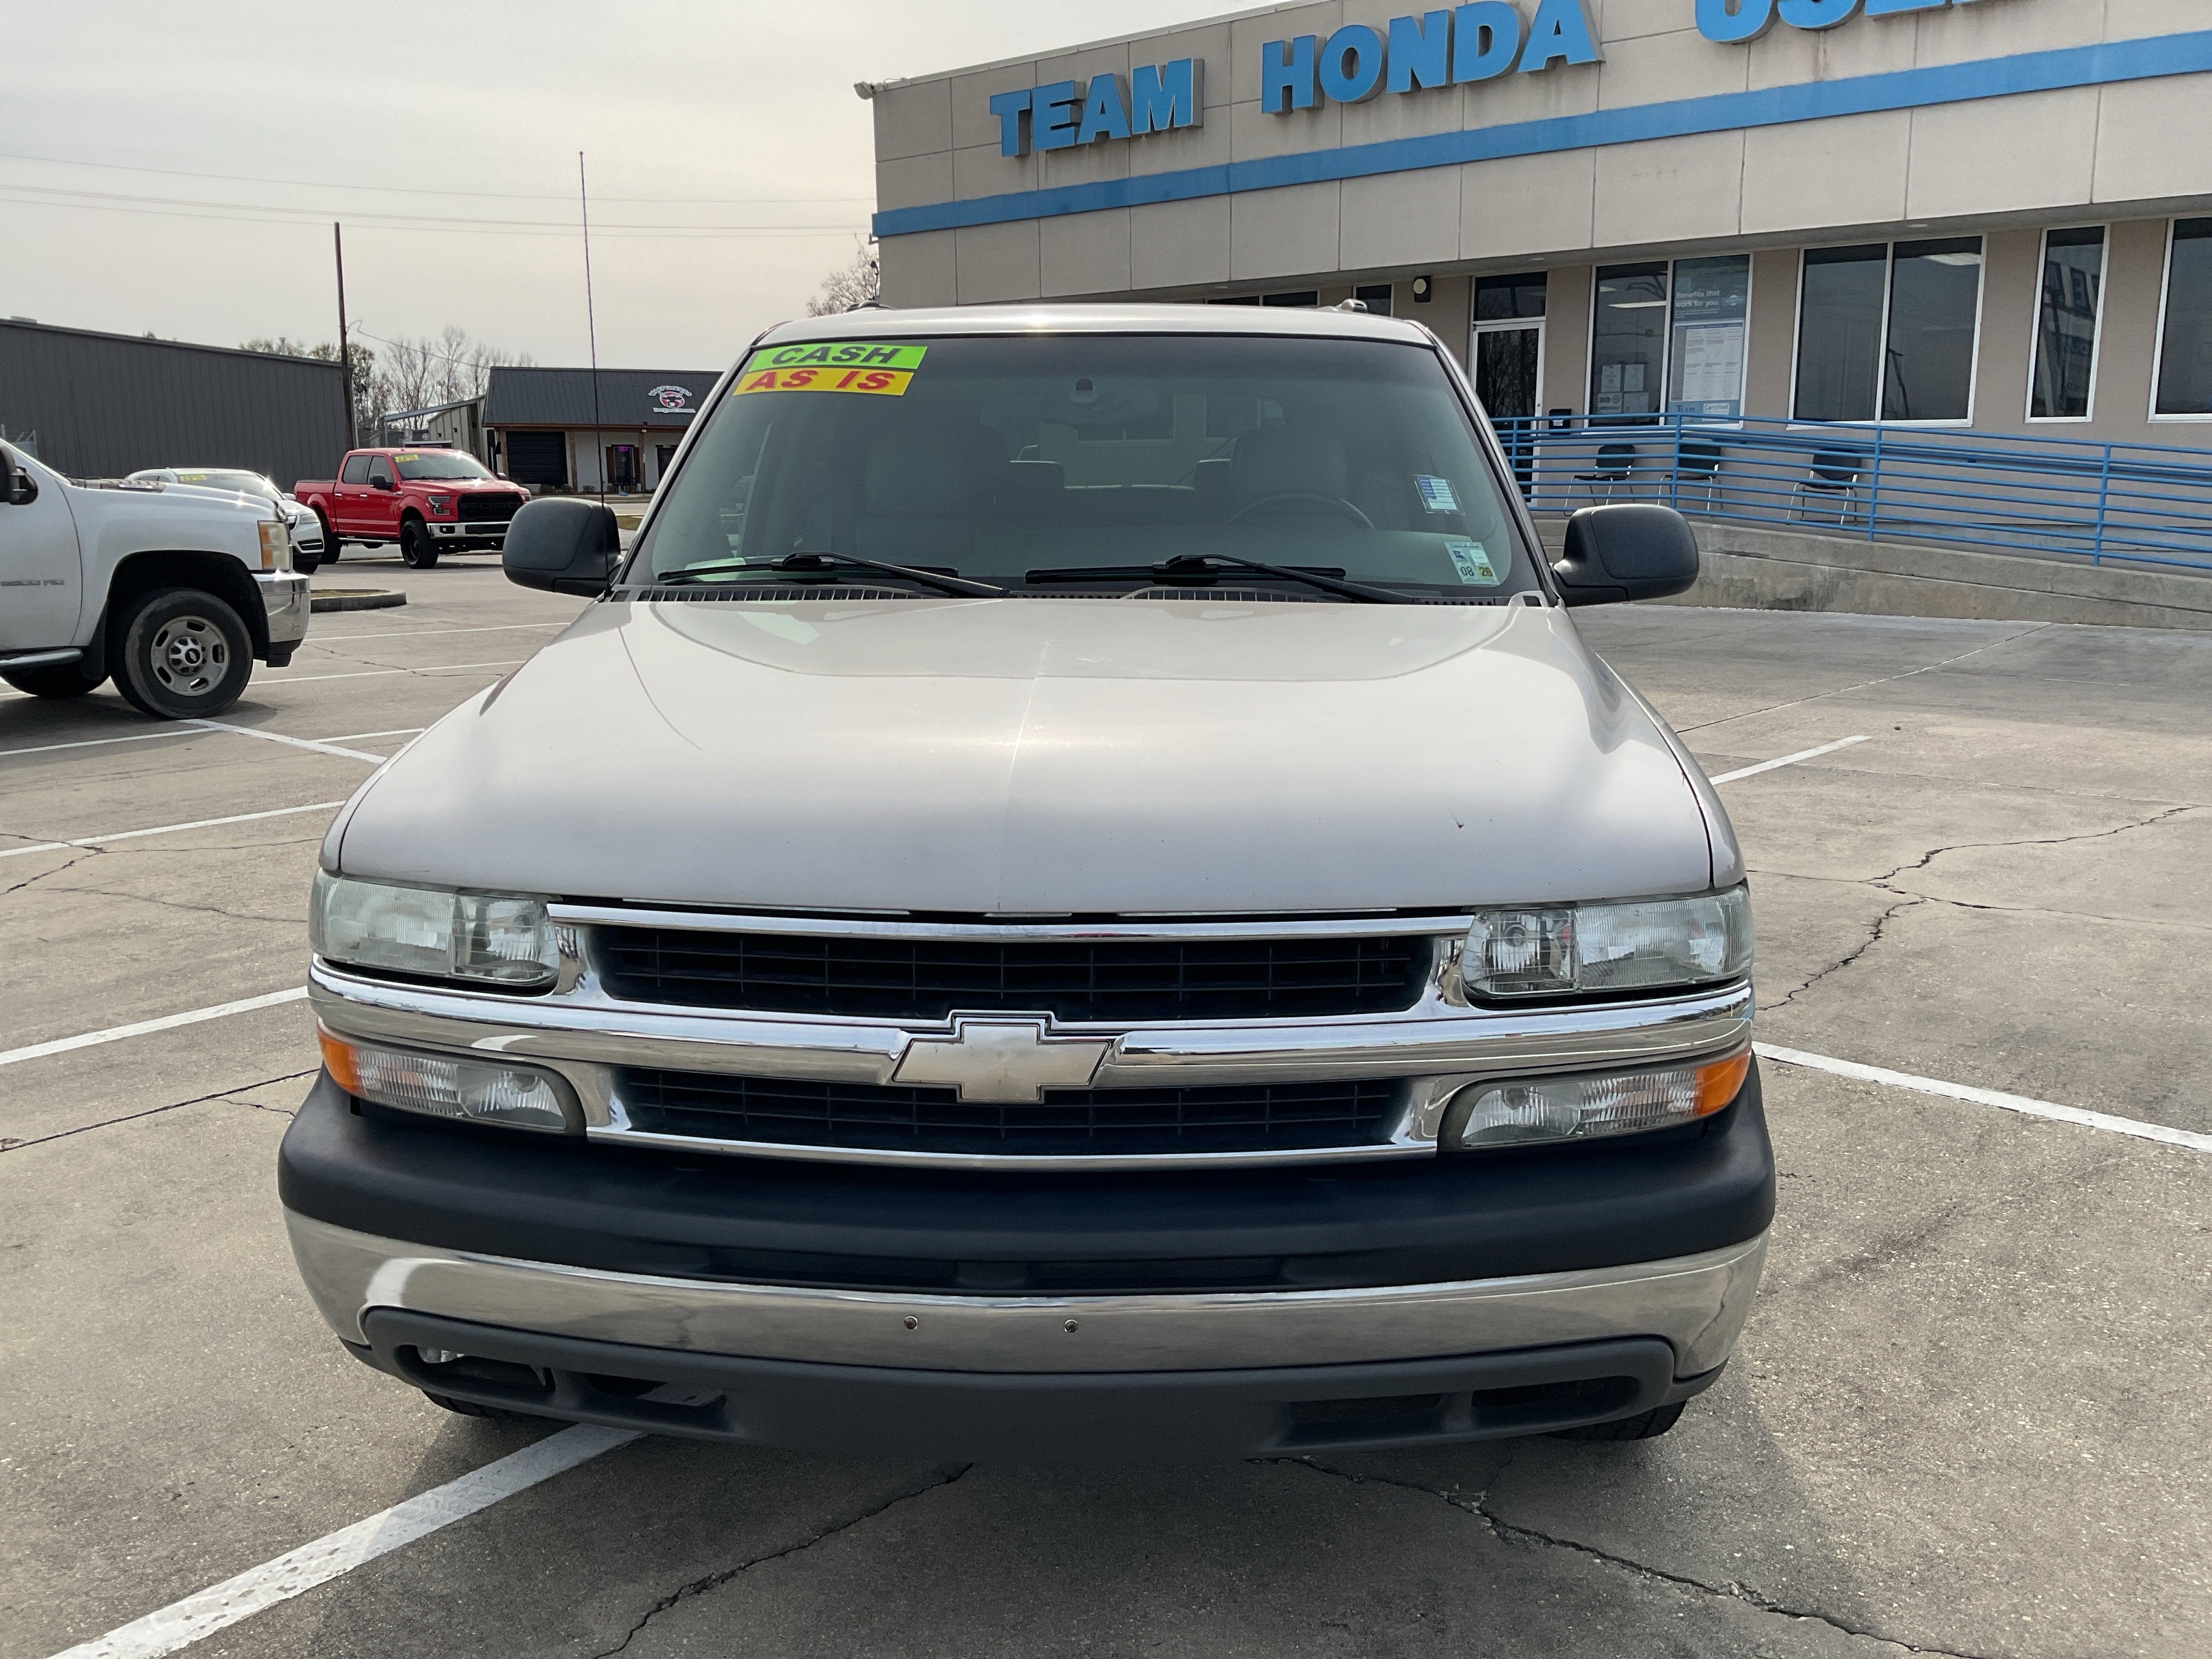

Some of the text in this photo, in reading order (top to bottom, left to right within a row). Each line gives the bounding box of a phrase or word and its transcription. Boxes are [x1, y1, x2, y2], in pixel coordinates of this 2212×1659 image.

[990, 57, 1204, 158] TEAM
[1261, 0, 1605, 114] HONDA
[1675, 291, 1705, 299] Benefits
[771, 346, 904, 365] CASH
[744, 369, 897, 392] AS IS
[1460, 566, 1493, 577] 08 26
